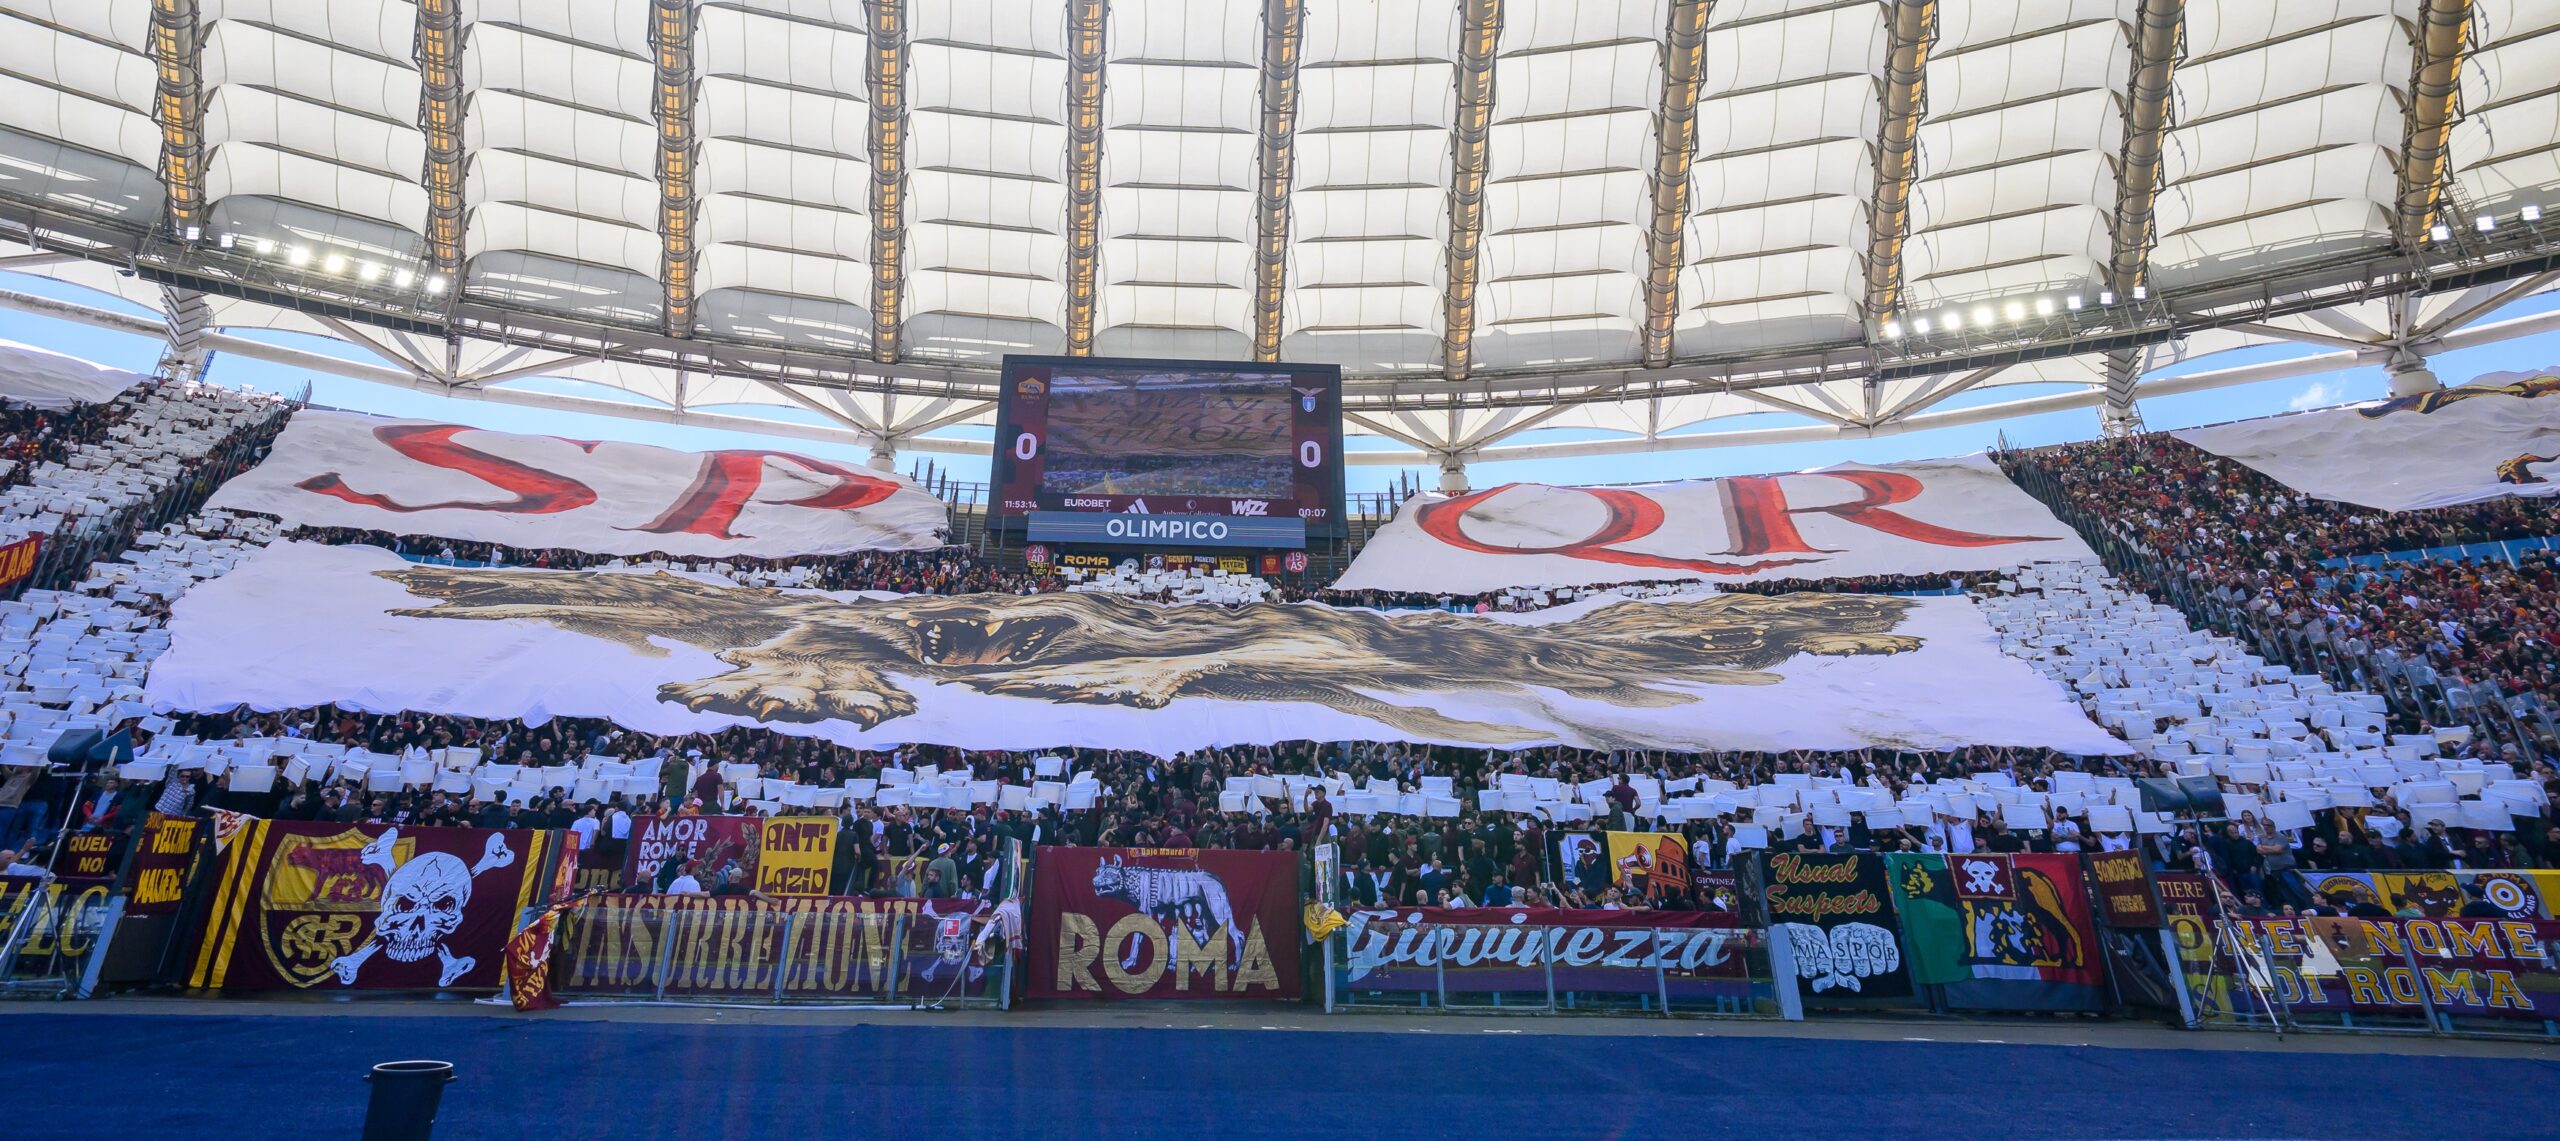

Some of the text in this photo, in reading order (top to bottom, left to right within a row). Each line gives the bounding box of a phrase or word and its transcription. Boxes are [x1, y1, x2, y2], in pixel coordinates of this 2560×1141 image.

[1016, 433, 1037, 460] 0
[1300, 440, 1321, 468] 0
[1005, 500, 1037, 509] 11:53:14
[1064, 498, 1111, 508] EUROBET
[1298, 508, 1326, 518] 00:07
[1106, 518, 1229, 540] OLIMPICO
[1030, 554, 1044, 563] AD
[1033, 545, 1044, 554] 20
[1064, 555, 1109, 566] ROMA
[1290, 551, 1302, 561] 19
[1290, 561, 1303, 571] AS
[643, 819, 708, 842] AMOR
[638, 841, 697, 860] ROME
[1770, 852, 1858, 883] Usual
[1765, 884, 1881, 922] Suspects
[1346, 910, 1730, 983] Giovinezza
[2359, 919, 2548, 960] NOME
[1057, 912, 1280, 994] ROMA
[2342, 966, 2537, 1011] ROMA
